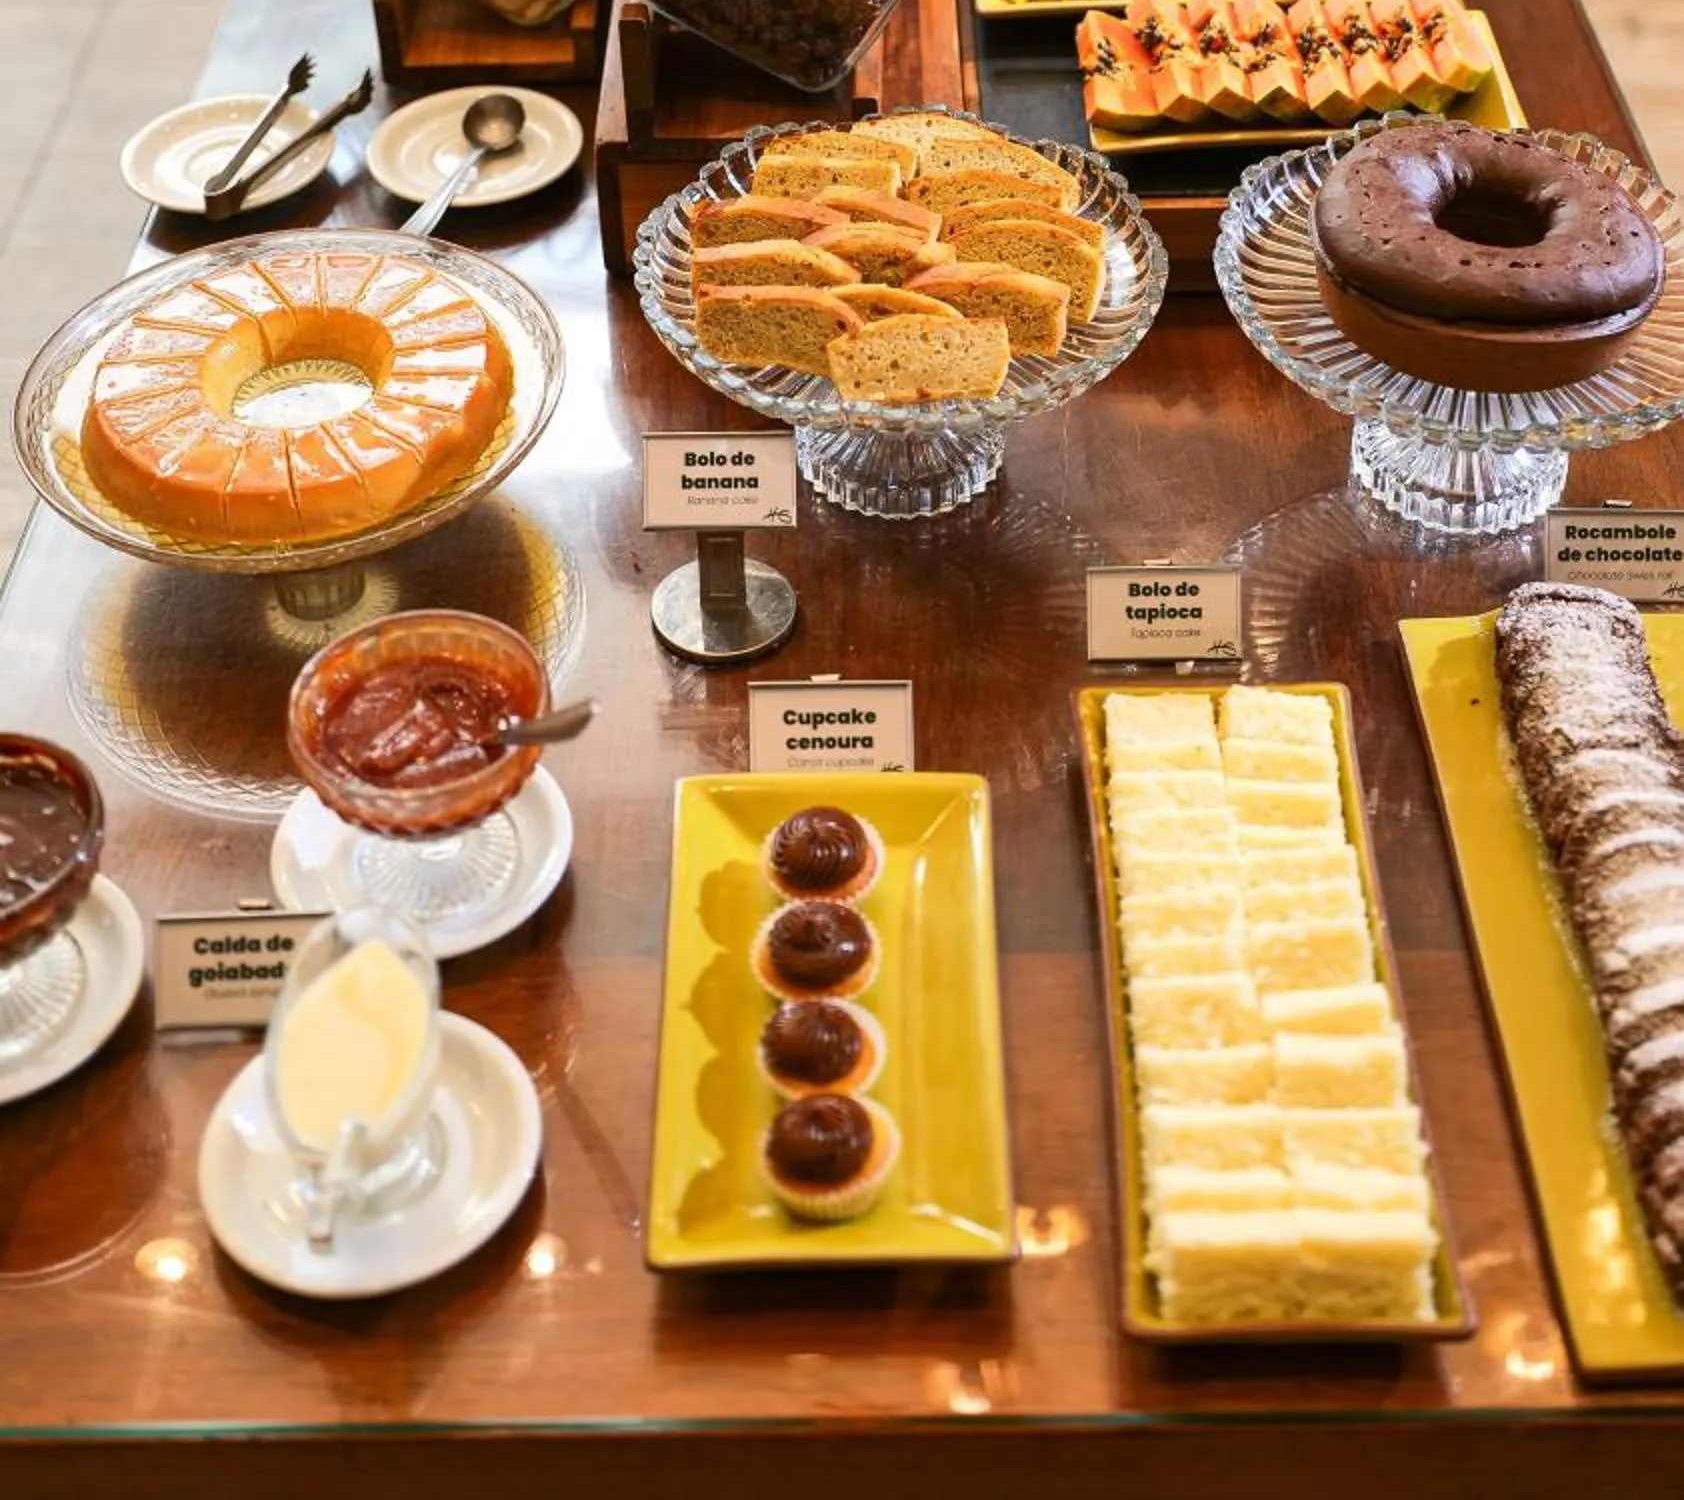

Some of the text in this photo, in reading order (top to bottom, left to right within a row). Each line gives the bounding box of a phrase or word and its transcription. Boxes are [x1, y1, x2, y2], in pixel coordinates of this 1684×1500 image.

[685, 451, 755, 467] Bolo de
[681, 474, 759, 489] banana
[1565, 524, 1677, 539] Rocambole
[1558, 547, 1684, 562] de chocolate
[1128, 582, 1200, 597] Bolo de
[1125, 604, 1203, 624] tapioca
[782, 708, 877, 730] Cupcake
[786, 735, 874, 750] cenoura
[193, 935, 295, 954] Calda de
[189, 961, 287, 988] goiabad
